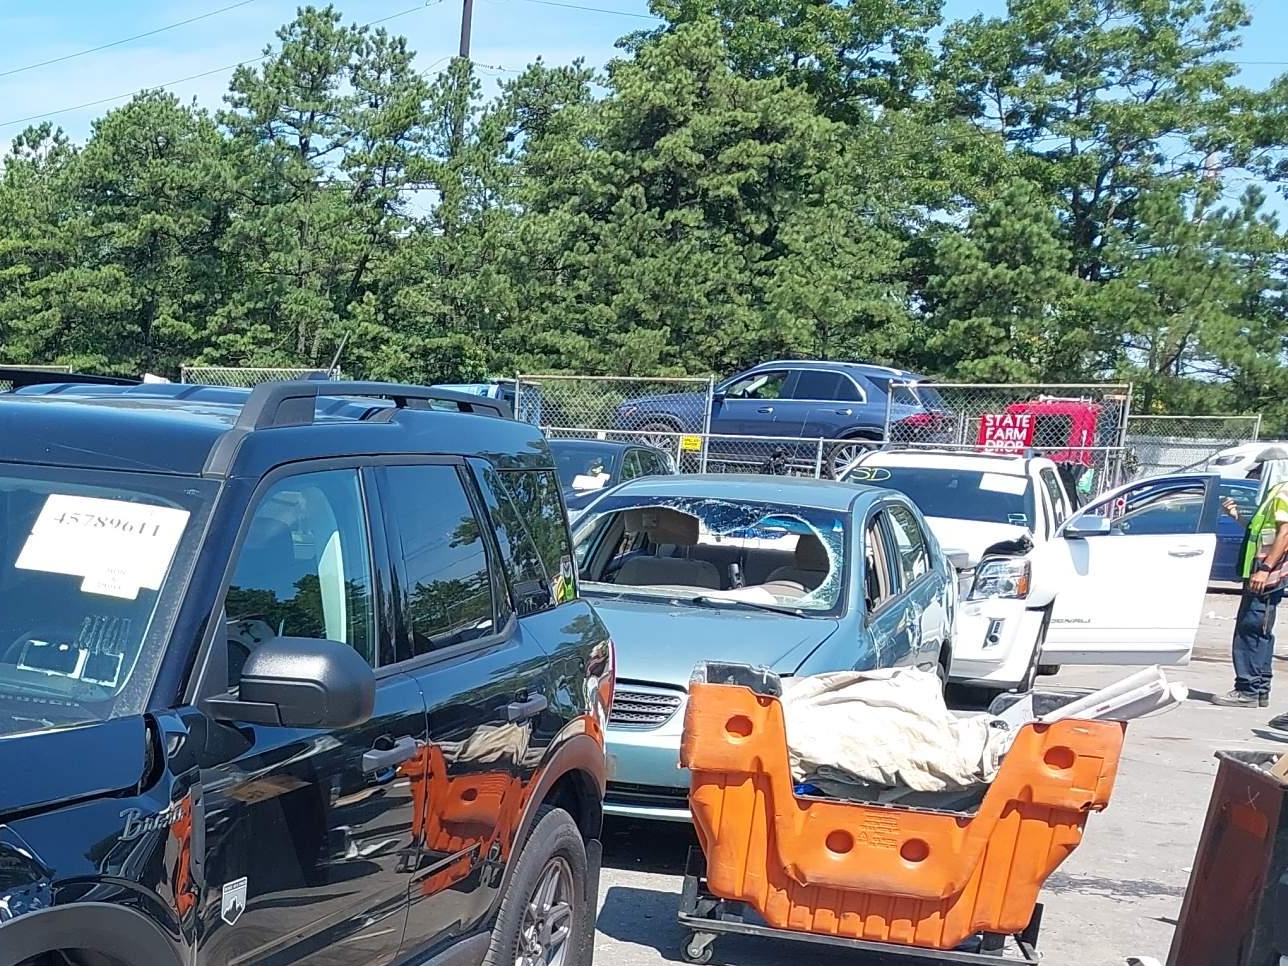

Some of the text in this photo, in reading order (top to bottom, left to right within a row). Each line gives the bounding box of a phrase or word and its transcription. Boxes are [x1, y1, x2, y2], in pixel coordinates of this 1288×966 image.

[985, 414, 1031, 428] STATE
[985, 427, 1027, 441] FARM
[984, 440, 1025, 453] DROP
[54, 511, 160, 537] 45789611
